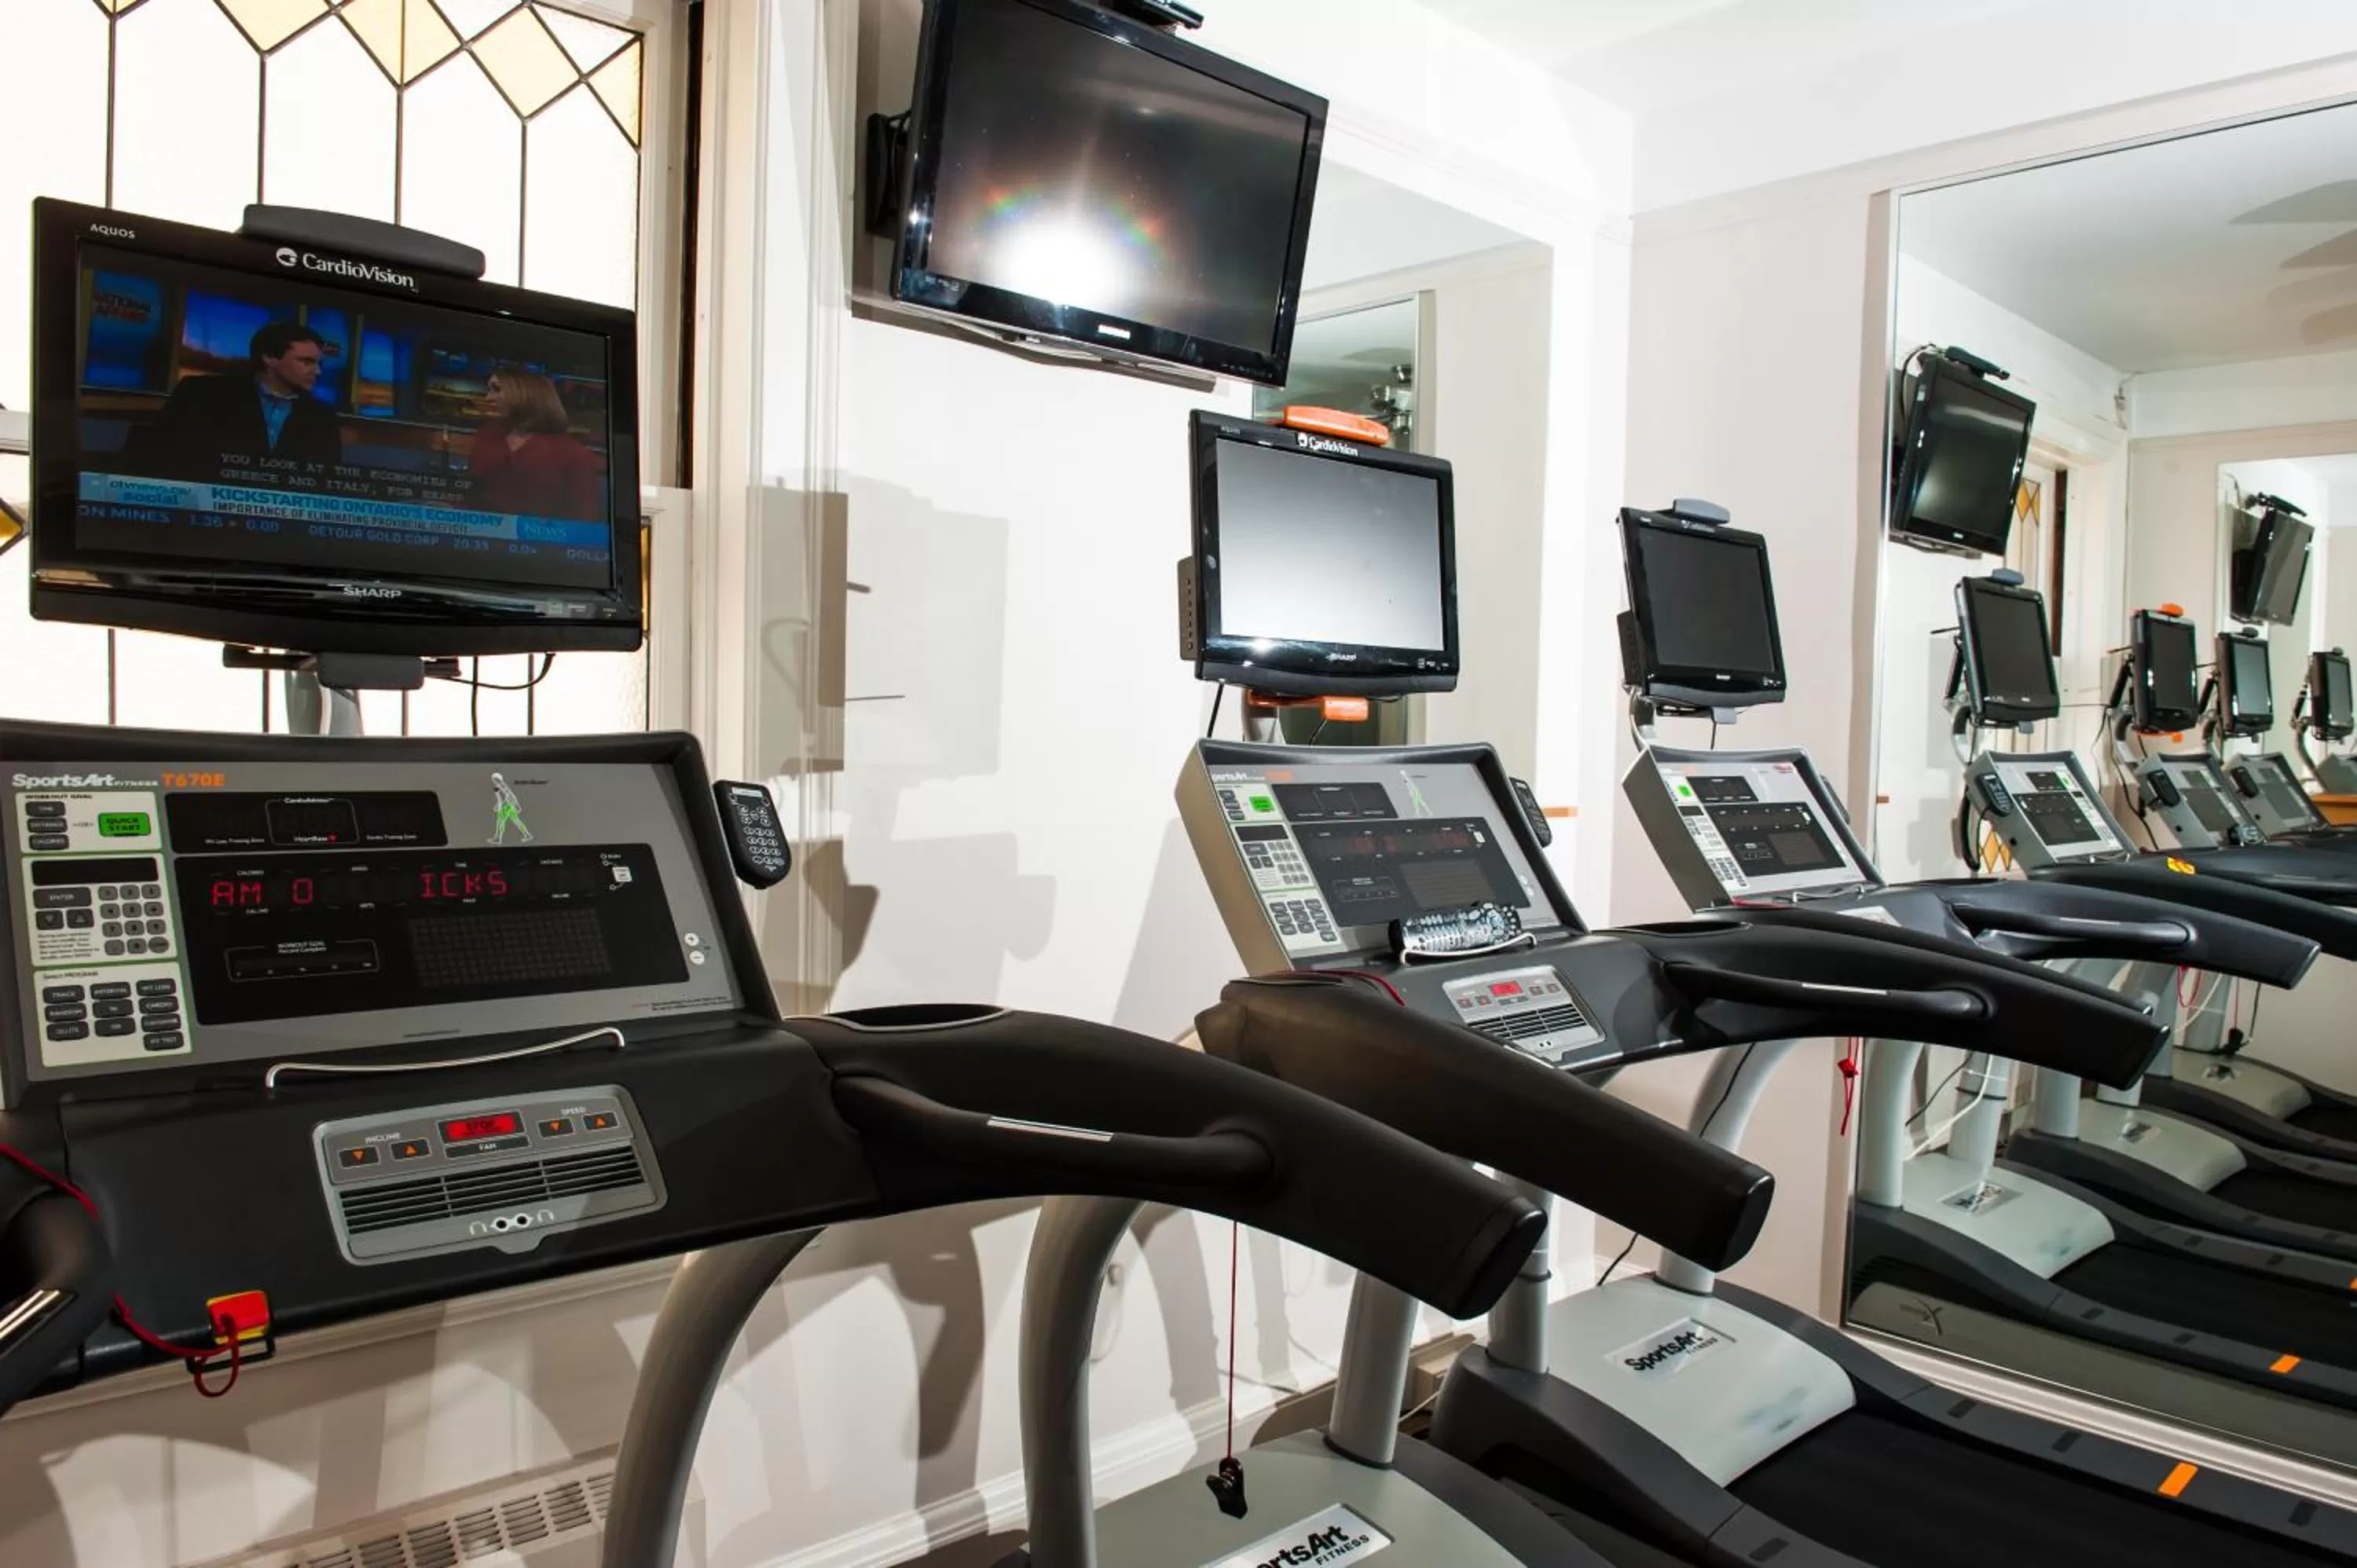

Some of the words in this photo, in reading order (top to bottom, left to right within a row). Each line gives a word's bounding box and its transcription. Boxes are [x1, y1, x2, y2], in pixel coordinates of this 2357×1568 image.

[90, 223, 136, 240] AQUOS
[302, 252, 416, 289] CardioVision
[220, 452, 251, 466] YOU
[260, 456, 297, 471] LOOK
[306, 462, 324, 474] AT
[455, 478, 474, 490] OF
[289, 476, 317, 489] AND
[211, 485, 341, 510] KICKSTARTING
[344, 500, 422, 519] ONTARIO'S
[425, 509, 504, 526] ECONOMY
[213, 500, 290, 518] IMPORTANCE
[291, 508, 305, 518] OF
[111, 508, 170, 523] MINES
[524, 523, 566, 539] NEWS
[343, 584, 402, 599] SHARP
[12, 773, 115, 789] SportsArt
[161, 772, 227, 788] T670E
[420, 870, 510, 898] ICKS
[213, 881, 262, 905] AM
[561, 1105, 586, 1116] SPEED
[365, 1132, 401, 1144] INCLINE
[478, 1142, 498, 1152] FAN
[1623, 1331, 1704, 1371] SportsArt
[1315, 1533, 1371, 1566] FITNESS
